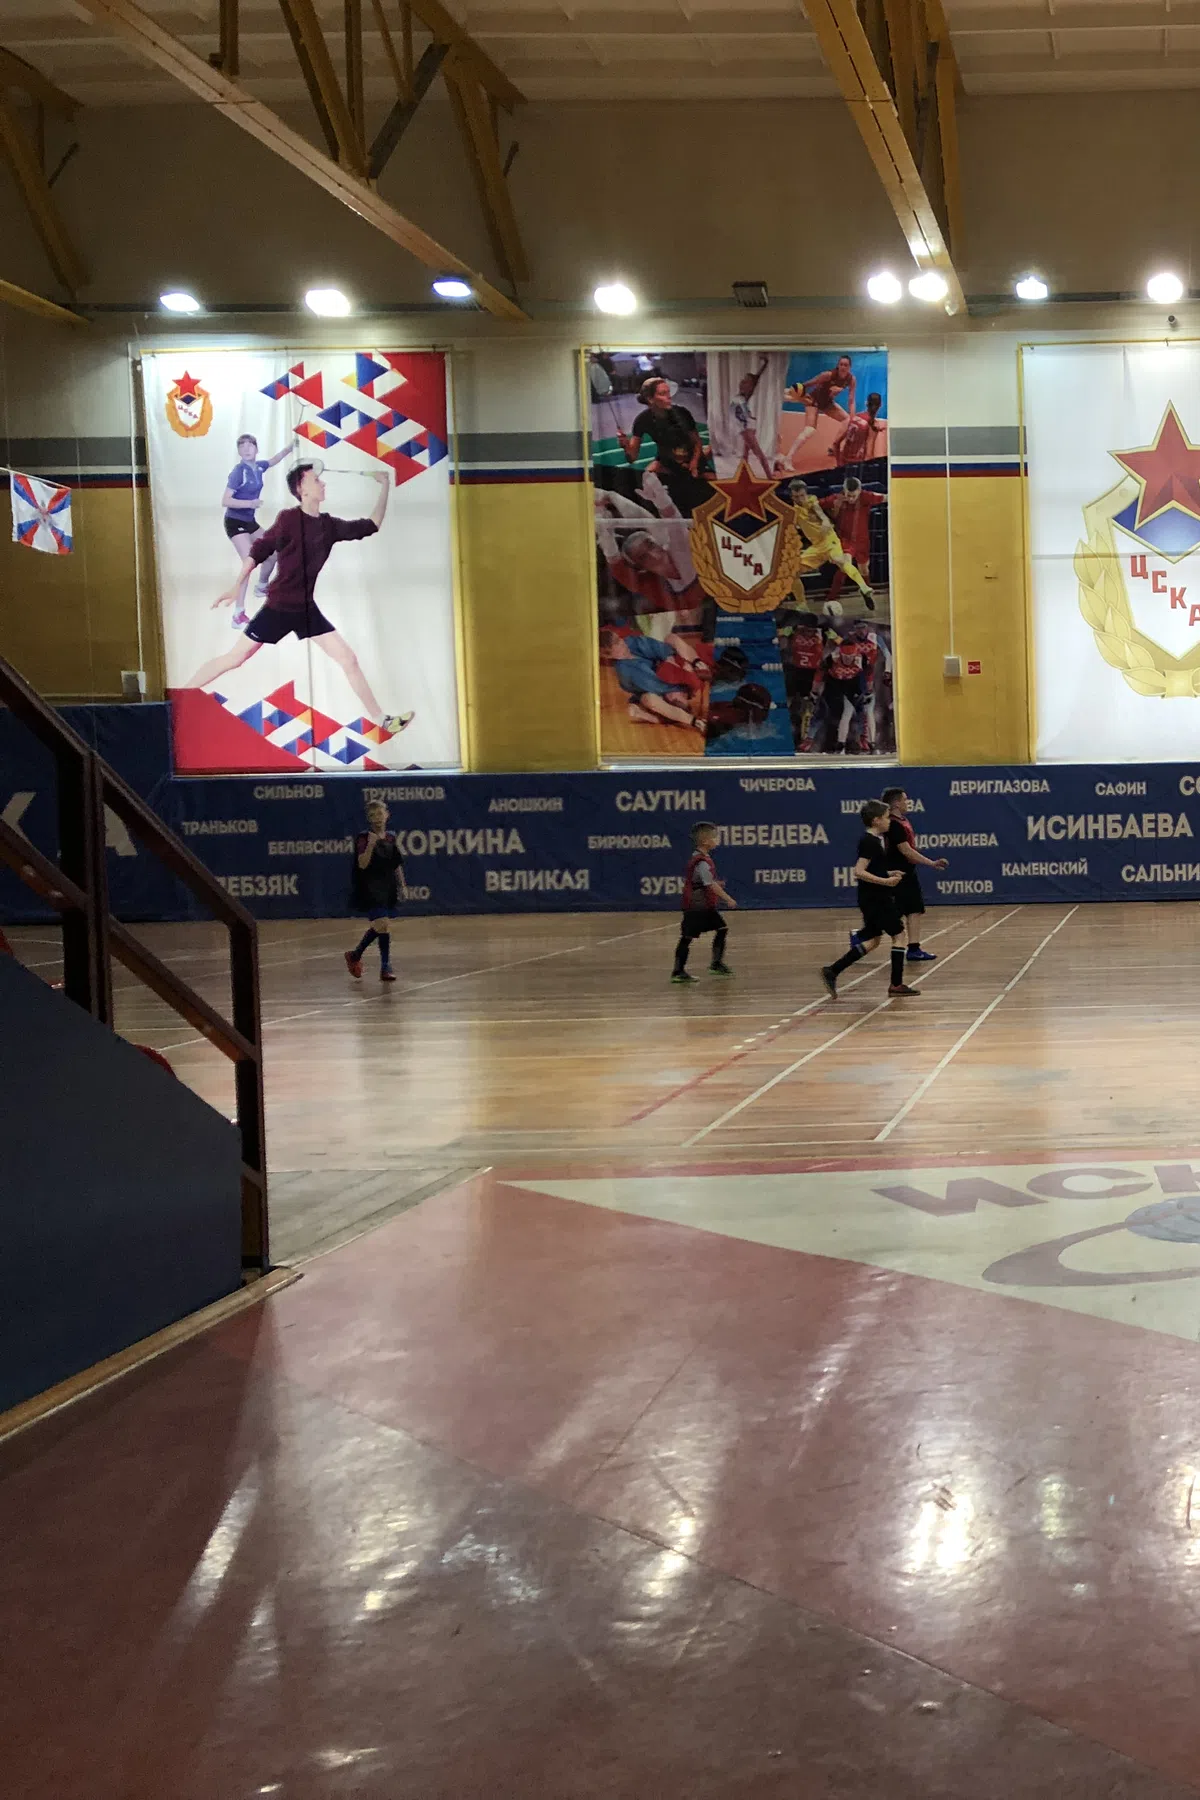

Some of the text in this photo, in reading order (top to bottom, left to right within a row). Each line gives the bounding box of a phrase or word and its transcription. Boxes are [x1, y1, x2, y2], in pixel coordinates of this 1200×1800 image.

[721, 536, 764, 576] ЦСКА
[254, 784, 324, 800] СИЛЬНОВ
[740, 778, 815, 791] ЧИЧЕРОВА
[950, 780, 1050, 795] ДЕРИГЛАЗОВА
[1095, 782, 1146, 795] САФИН
[488, 798, 563, 812] АНОШКИН
[616, 790, 705, 811] САУТИН
[181, 820, 258, 836] ТРАНЬКОВ
[1028, 813, 1193, 840] ИСИНБАЕВА
[588, 835, 671, 849] БИРЮКОВА
[716, 824, 829, 847] ЛЕБЕДЕВА
[268, 837, 354, 855] БЕЛЯВСКИЙ
[1002, 858, 1087, 876] КАМЕНСКИЙ
[486, 869, 589, 891] ВЕЛИКАЯ
[755, 869, 806, 884] ГЕДУЕВ
[937, 880, 993, 893] ЧУПКОВ
